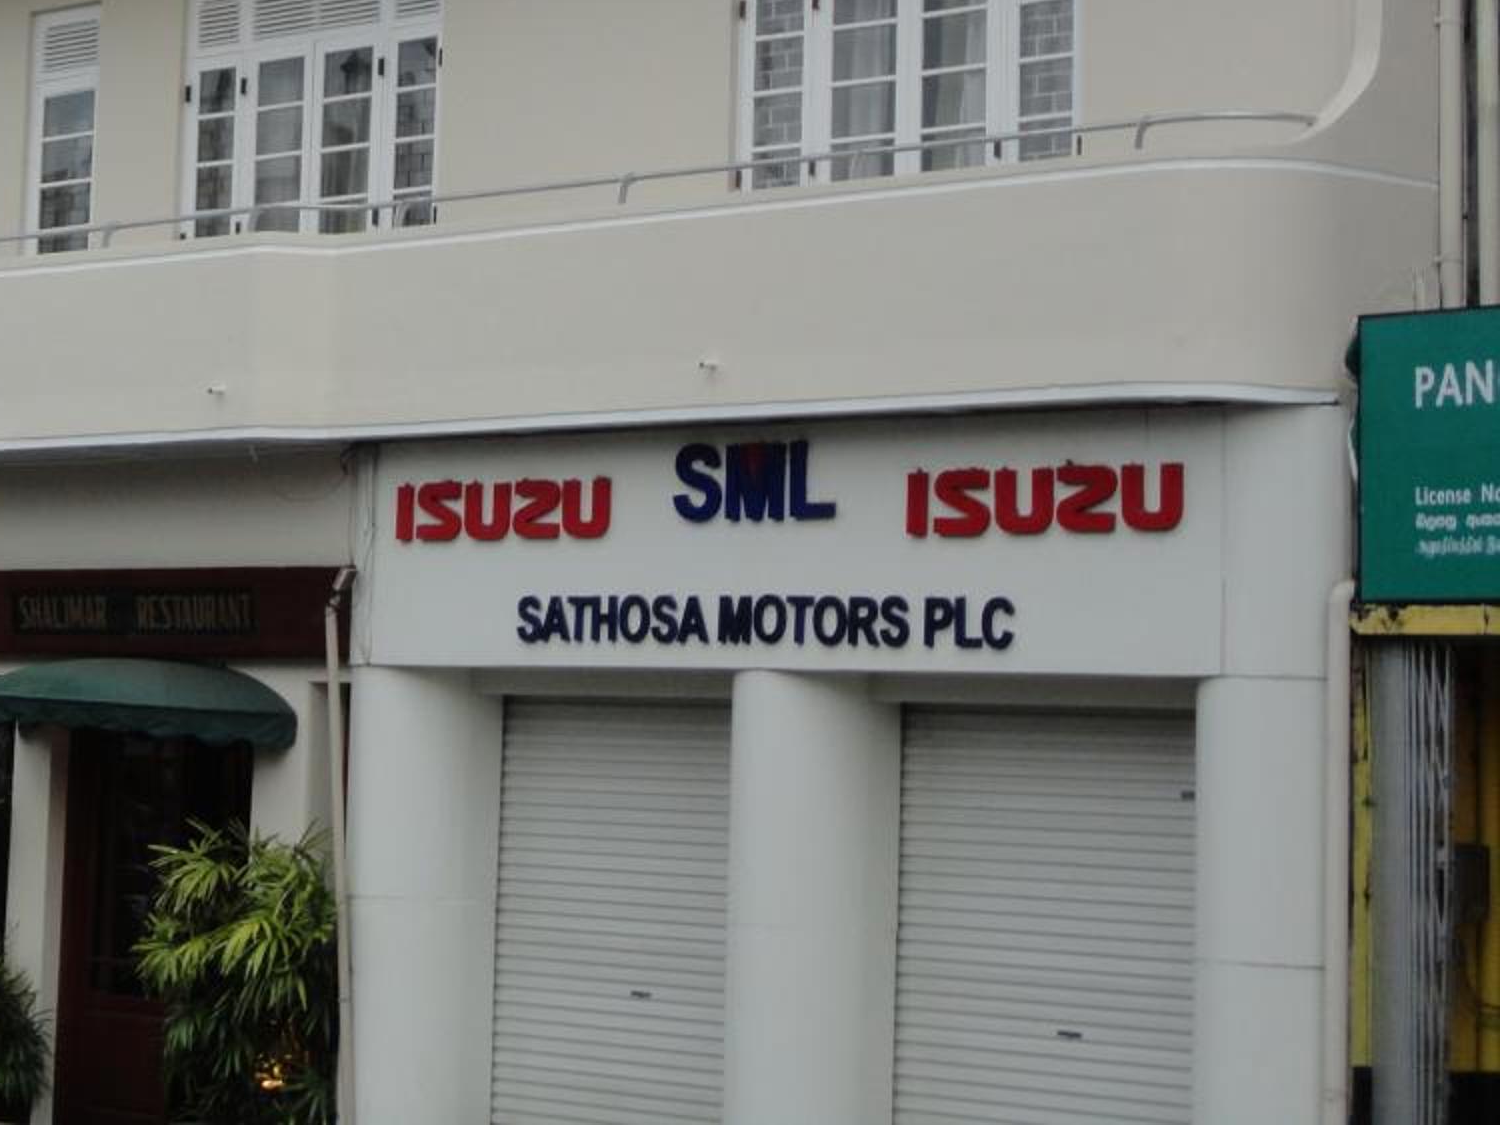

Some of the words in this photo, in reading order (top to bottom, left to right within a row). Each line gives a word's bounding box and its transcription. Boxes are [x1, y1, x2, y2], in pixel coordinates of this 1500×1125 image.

[1414, 360, 1500, 408] PAN
[673, 440, 836, 522] SML
[907, 463, 1184, 537] ISUZU
[1415, 486, 1471, 507] License
[396, 477, 611, 541] ISUZU
[19, 594, 110, 631] SHALIMAR
[135, 593, 253, 631] RESTAURANT
[516, 595, 705, 645] SATHOSA
[718, 595, 911, 648] MOTORS
[924, 596, 1015, 650] PLC
